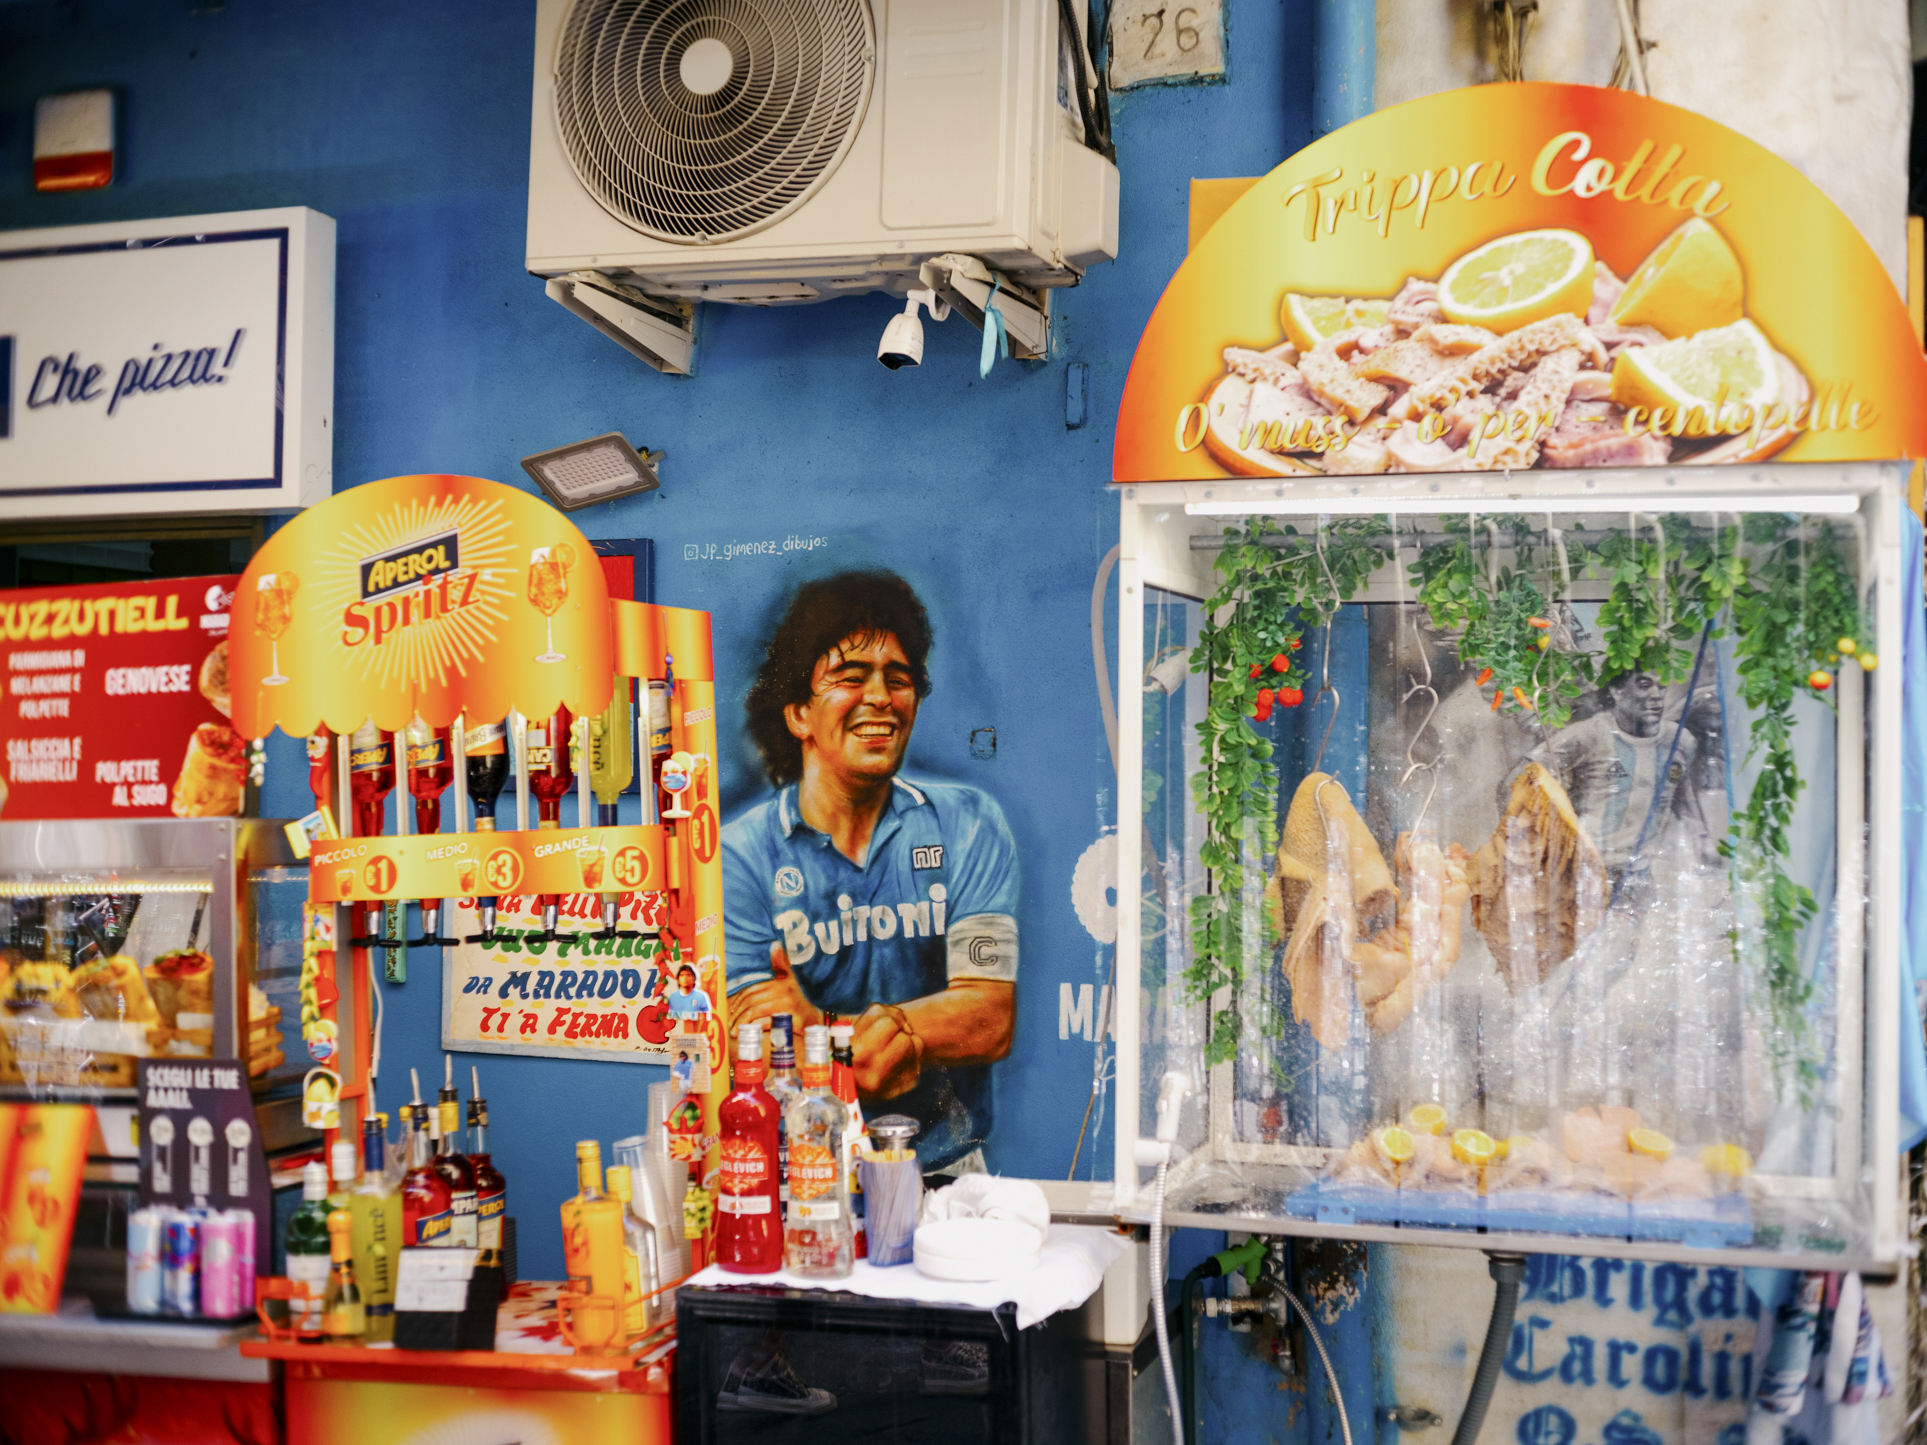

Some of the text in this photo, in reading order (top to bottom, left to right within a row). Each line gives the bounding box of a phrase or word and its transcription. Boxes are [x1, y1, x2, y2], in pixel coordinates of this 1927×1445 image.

[1282, 131, 1732, 242] Trippa Cotta
[26, 328, 243, 416] Che pizza!
[367, 545, 450, 592] APEROL
[342, 571, 481, 647] Spritz
[105, 663, 192, 696] GENOVESE
[314, 844, 368, 867] PICCOLO
[426, 842, 468, 861] MEDIO
[534, 835, 590, 858] GRANDE
[969, 936, 998, 967] C
